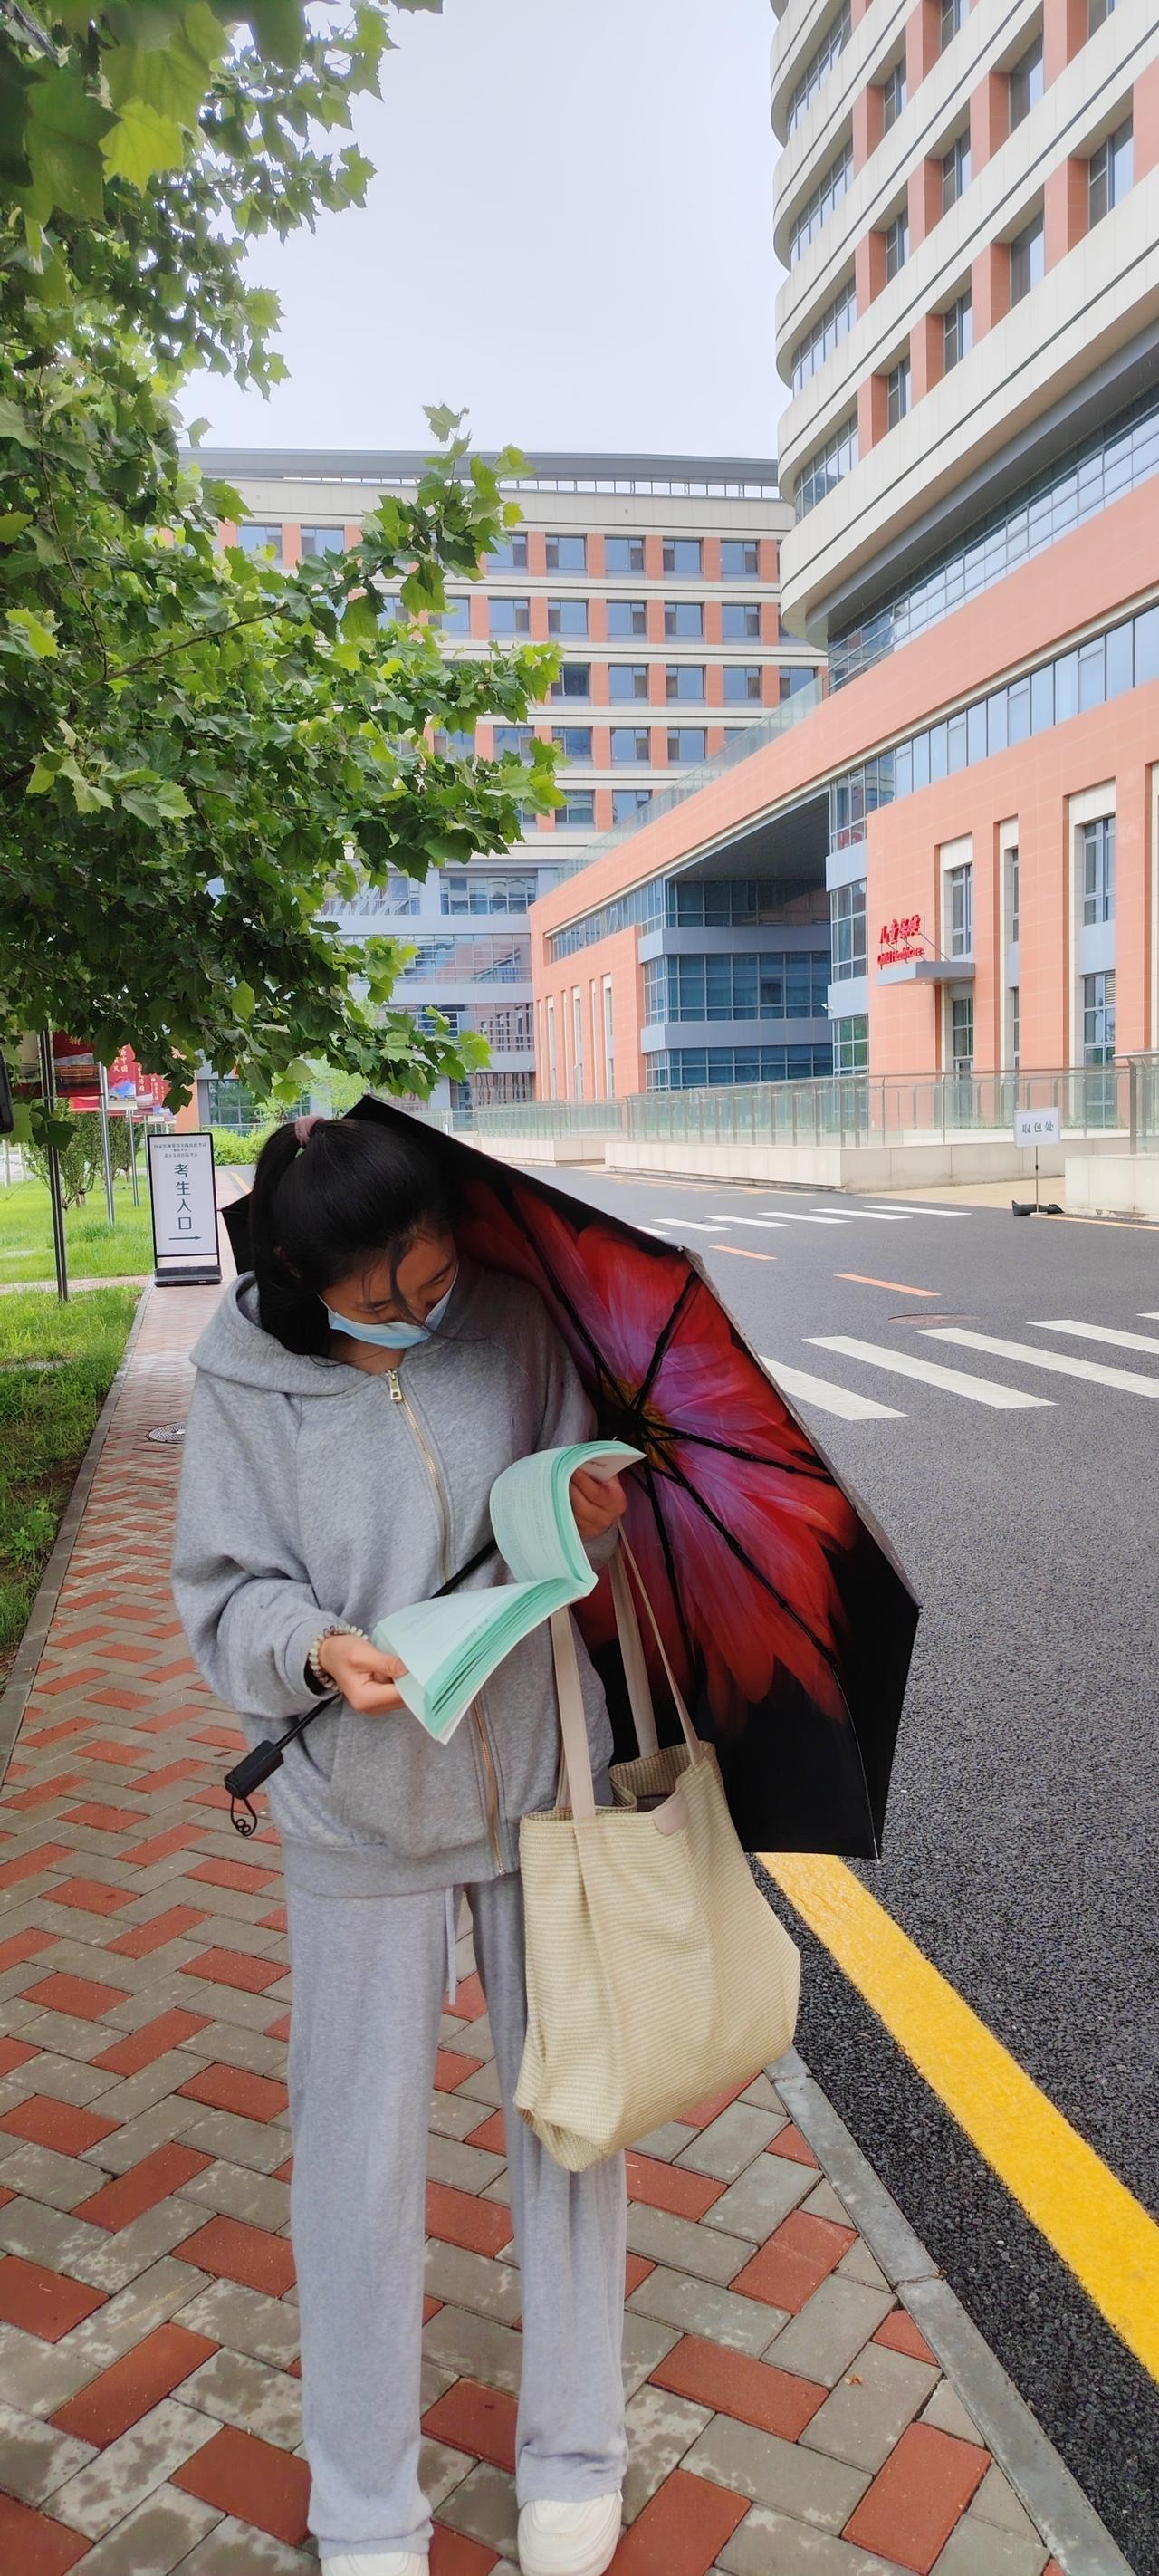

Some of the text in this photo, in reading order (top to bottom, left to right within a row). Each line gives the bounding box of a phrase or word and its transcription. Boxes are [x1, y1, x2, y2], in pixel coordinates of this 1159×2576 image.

[1021, 1120, 1054, 1133] 取包处
[174, 1163, 192, 1230] 考生入口
